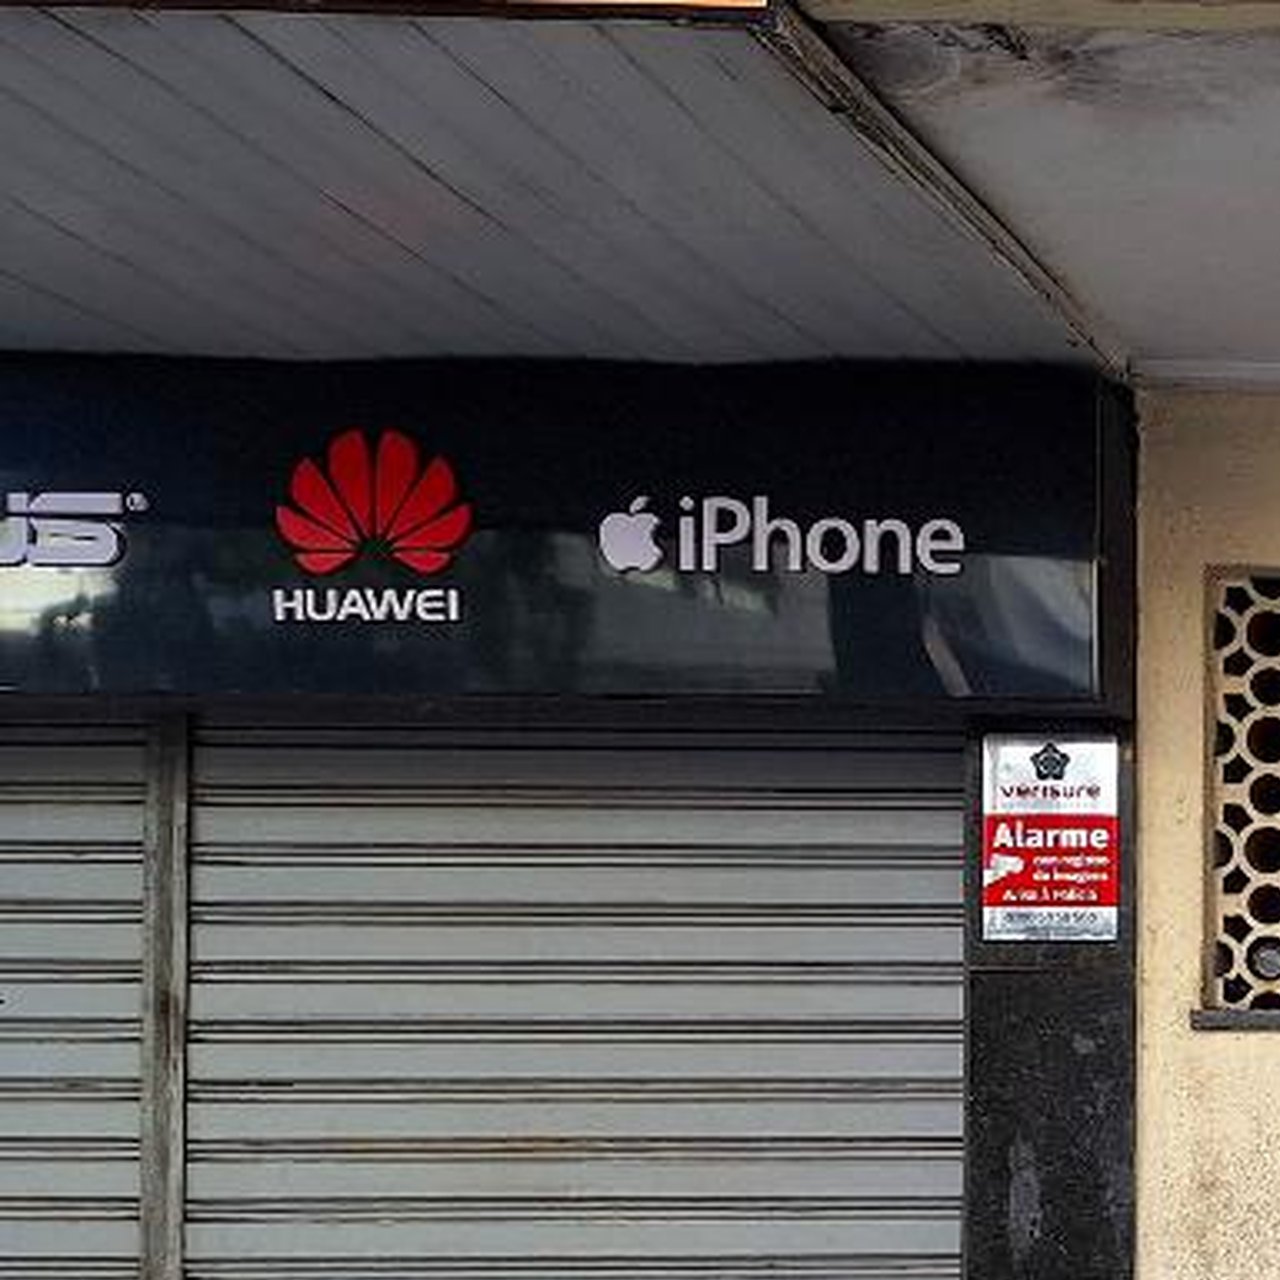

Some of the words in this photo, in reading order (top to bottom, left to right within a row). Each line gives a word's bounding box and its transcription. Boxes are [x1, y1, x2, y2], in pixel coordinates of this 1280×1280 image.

[678, 496, 966, 575] iPhone
[273, 588, 460, 622] HUAWEI
[1001, 785, 1101, 799] verisure
[993, 822, 1109, 848] Alarme
